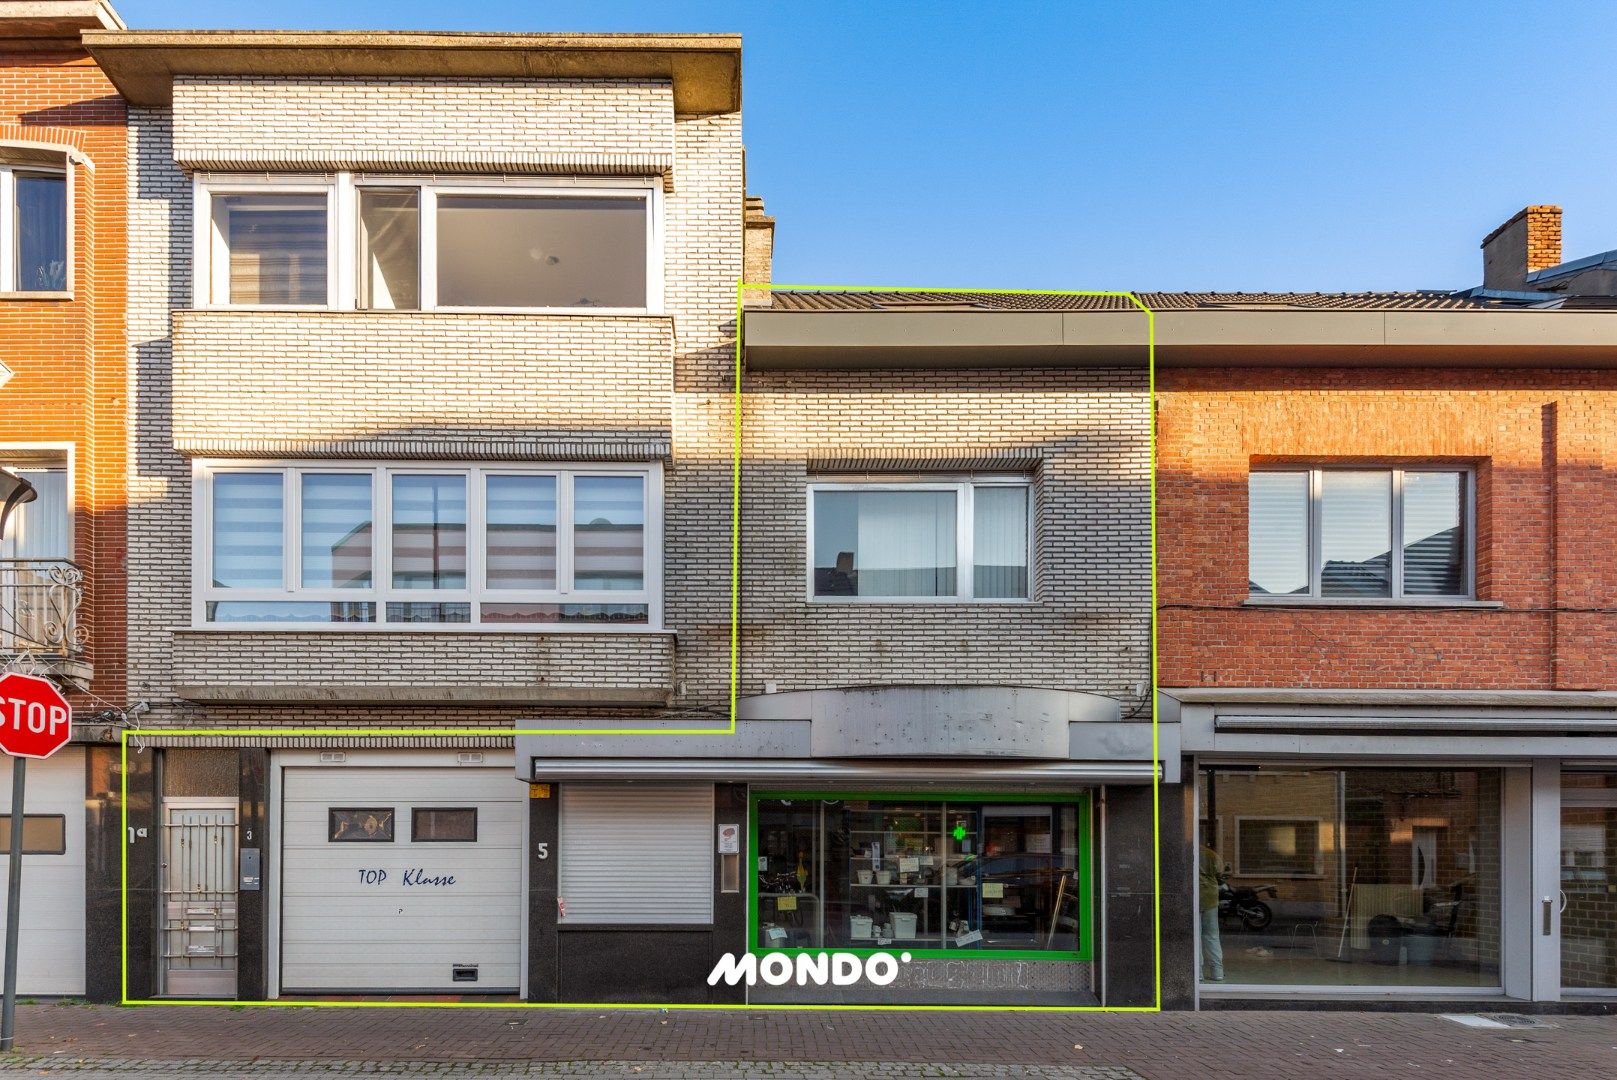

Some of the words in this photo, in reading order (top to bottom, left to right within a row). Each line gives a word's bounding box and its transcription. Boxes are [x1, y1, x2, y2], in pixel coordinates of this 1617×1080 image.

[246, 830, 253, 840] 3
[537, 842, 548, 860] 5
[358, 868, 388, 886] TOP
[402, 868, 456, 886] Klasse
